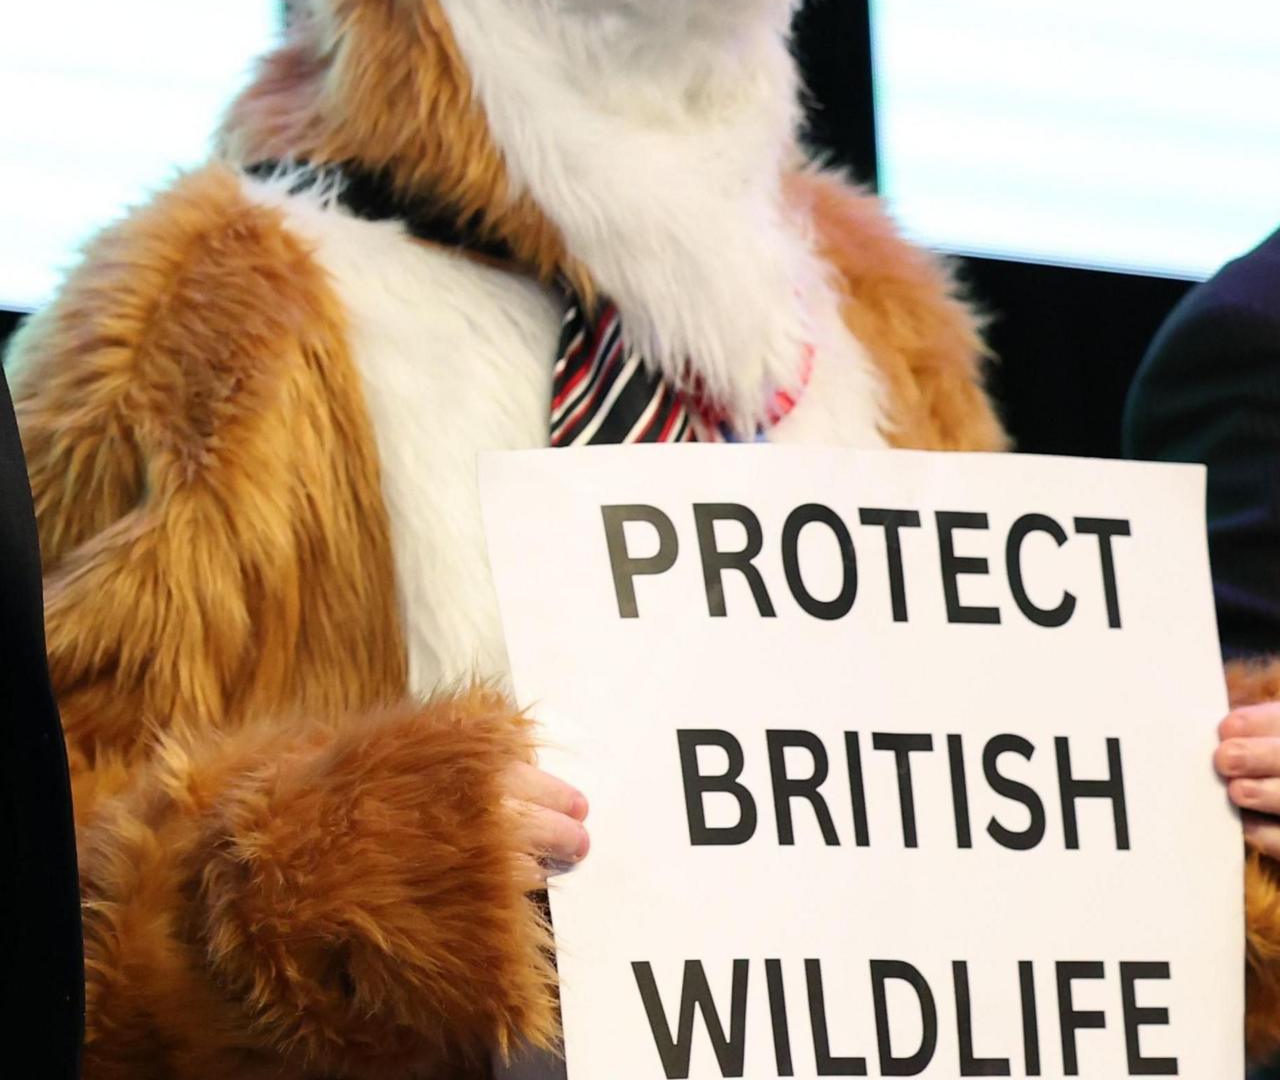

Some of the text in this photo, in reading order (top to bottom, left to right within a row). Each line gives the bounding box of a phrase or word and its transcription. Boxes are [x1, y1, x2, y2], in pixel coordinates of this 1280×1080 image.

[601, 502, 1132, 629] PROTECT
[676, 728, 1131, 851] BRITISH
[630, 958, 1179, 1080] WILDLIFE
